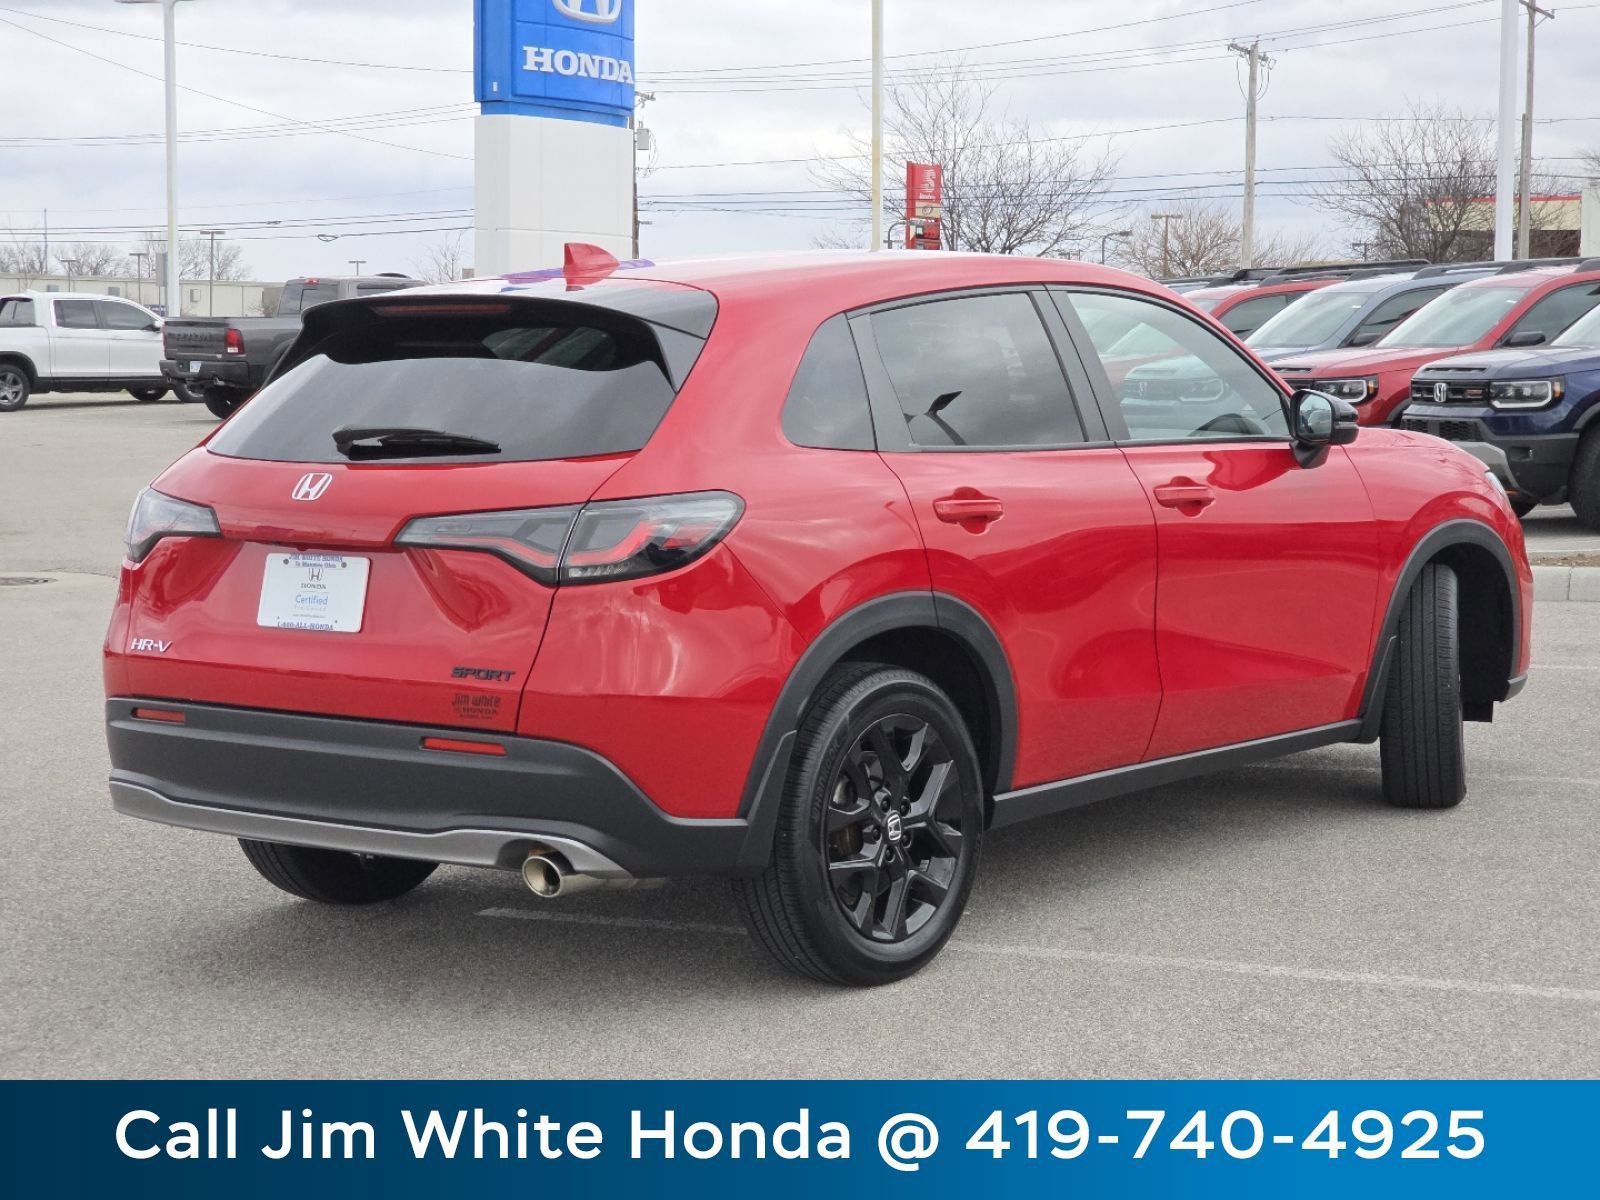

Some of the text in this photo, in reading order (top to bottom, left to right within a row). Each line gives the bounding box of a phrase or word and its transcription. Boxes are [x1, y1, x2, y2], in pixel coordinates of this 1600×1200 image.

[522, 46, 635, 85] HONDA
[295, 595, 328, 605] Certified
[131, 638, 173, 651] HR-V
[451, 667, 515, 681] SPORT
